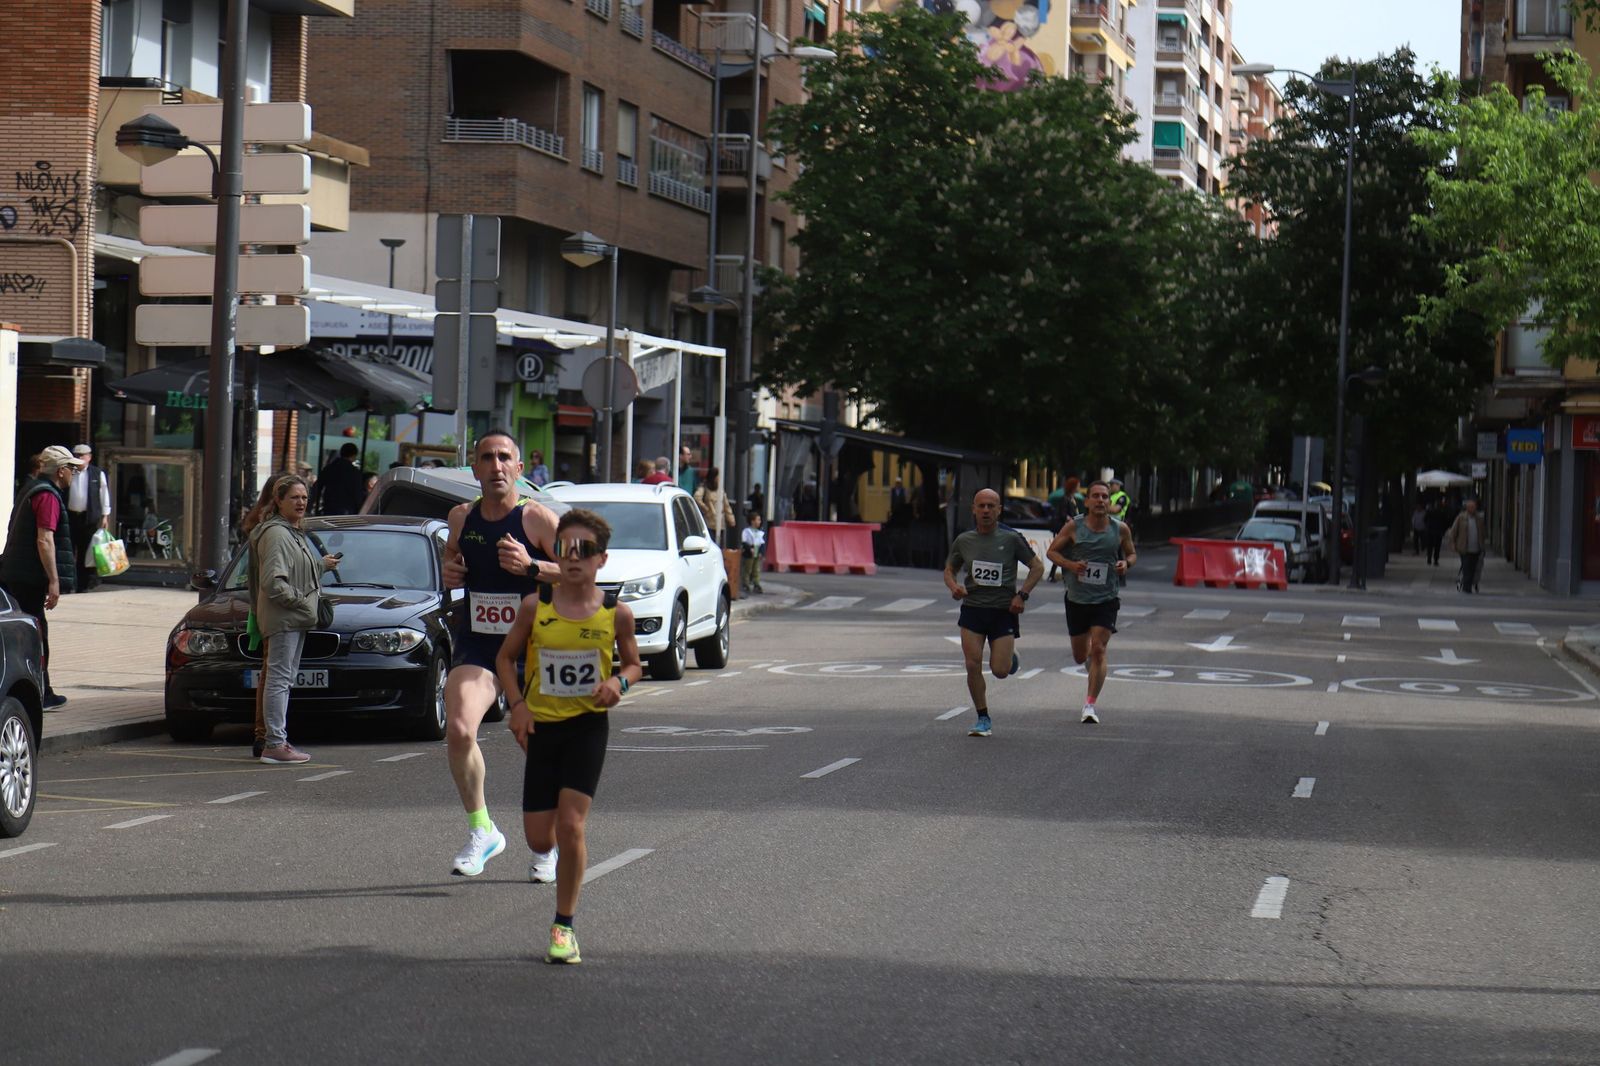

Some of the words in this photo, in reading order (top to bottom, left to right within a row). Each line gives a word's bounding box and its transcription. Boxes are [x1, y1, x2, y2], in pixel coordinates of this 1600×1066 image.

[974, 568, 1000, 581] 229
[475, 605, 516, 623] 260
[545, 663, 596, 686] 162
